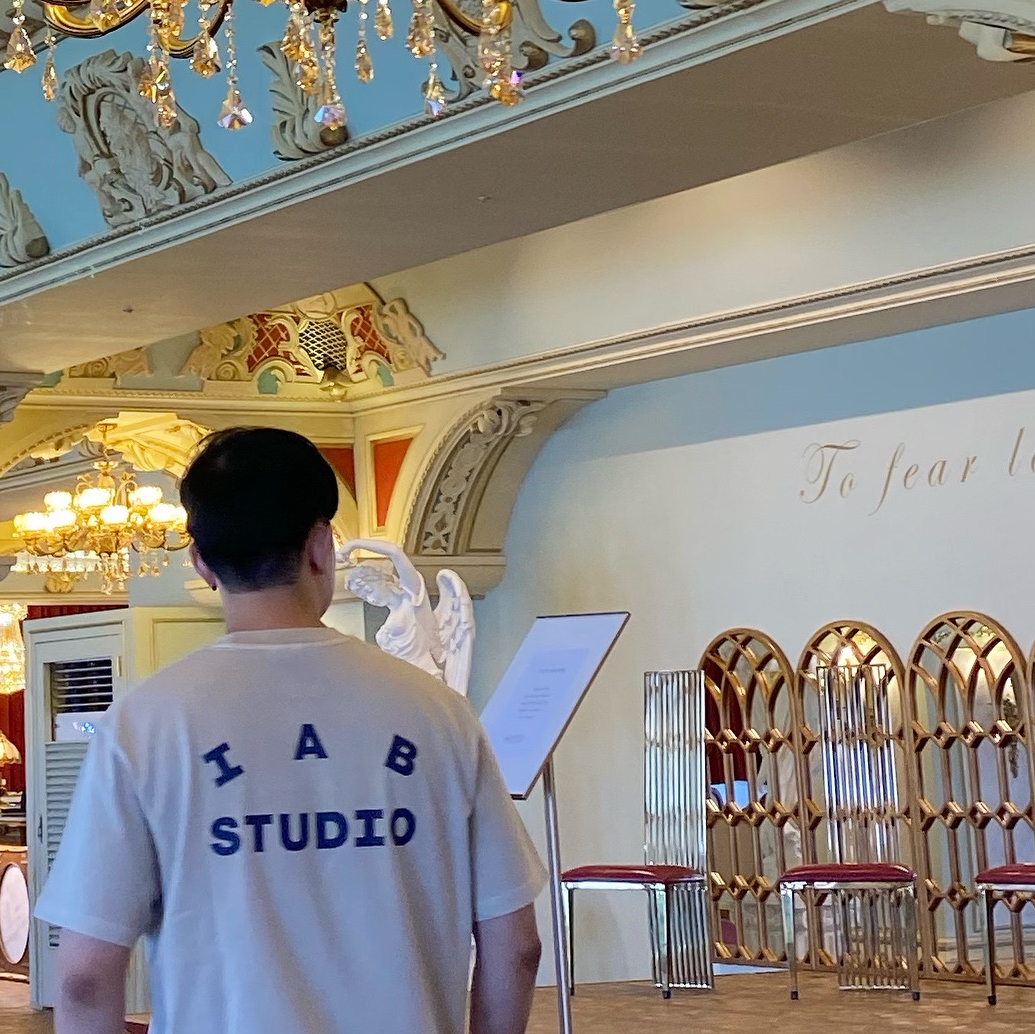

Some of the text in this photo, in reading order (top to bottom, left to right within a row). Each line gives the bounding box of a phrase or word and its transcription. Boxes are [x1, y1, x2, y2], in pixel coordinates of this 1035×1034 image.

[799, 440, 859, 504] To
[868, 443, 978, 516] fear
[211, 807, 416, 857] STUDIO
